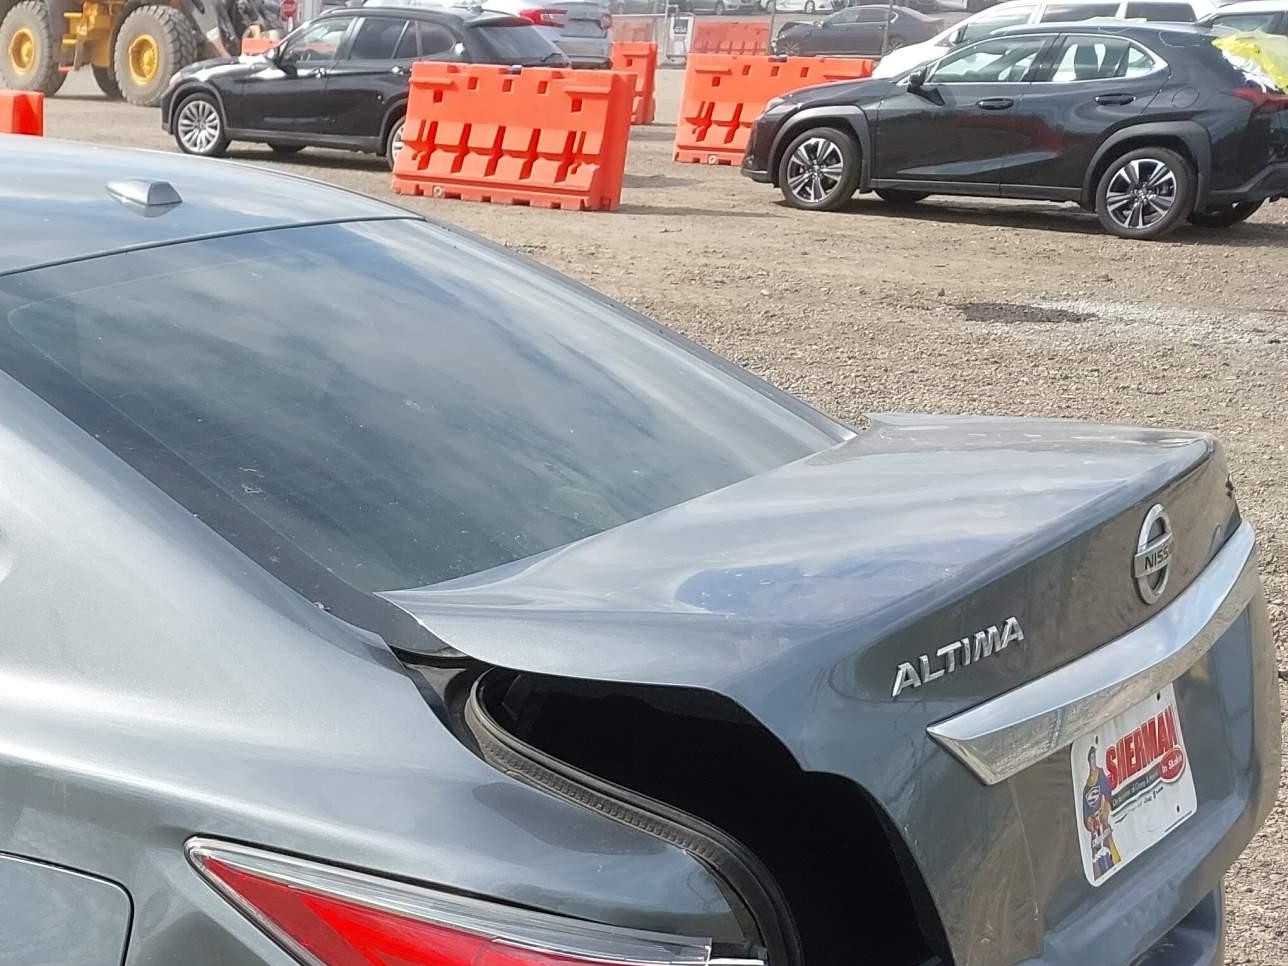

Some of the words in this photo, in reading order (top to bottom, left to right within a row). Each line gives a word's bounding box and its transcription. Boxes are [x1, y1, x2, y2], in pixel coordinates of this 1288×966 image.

[1144, 543, 1171, 571] NISS
[891, 616, 1025, 697] ALTIMA
[1105, 704, 1178, 790] SHERMAN
